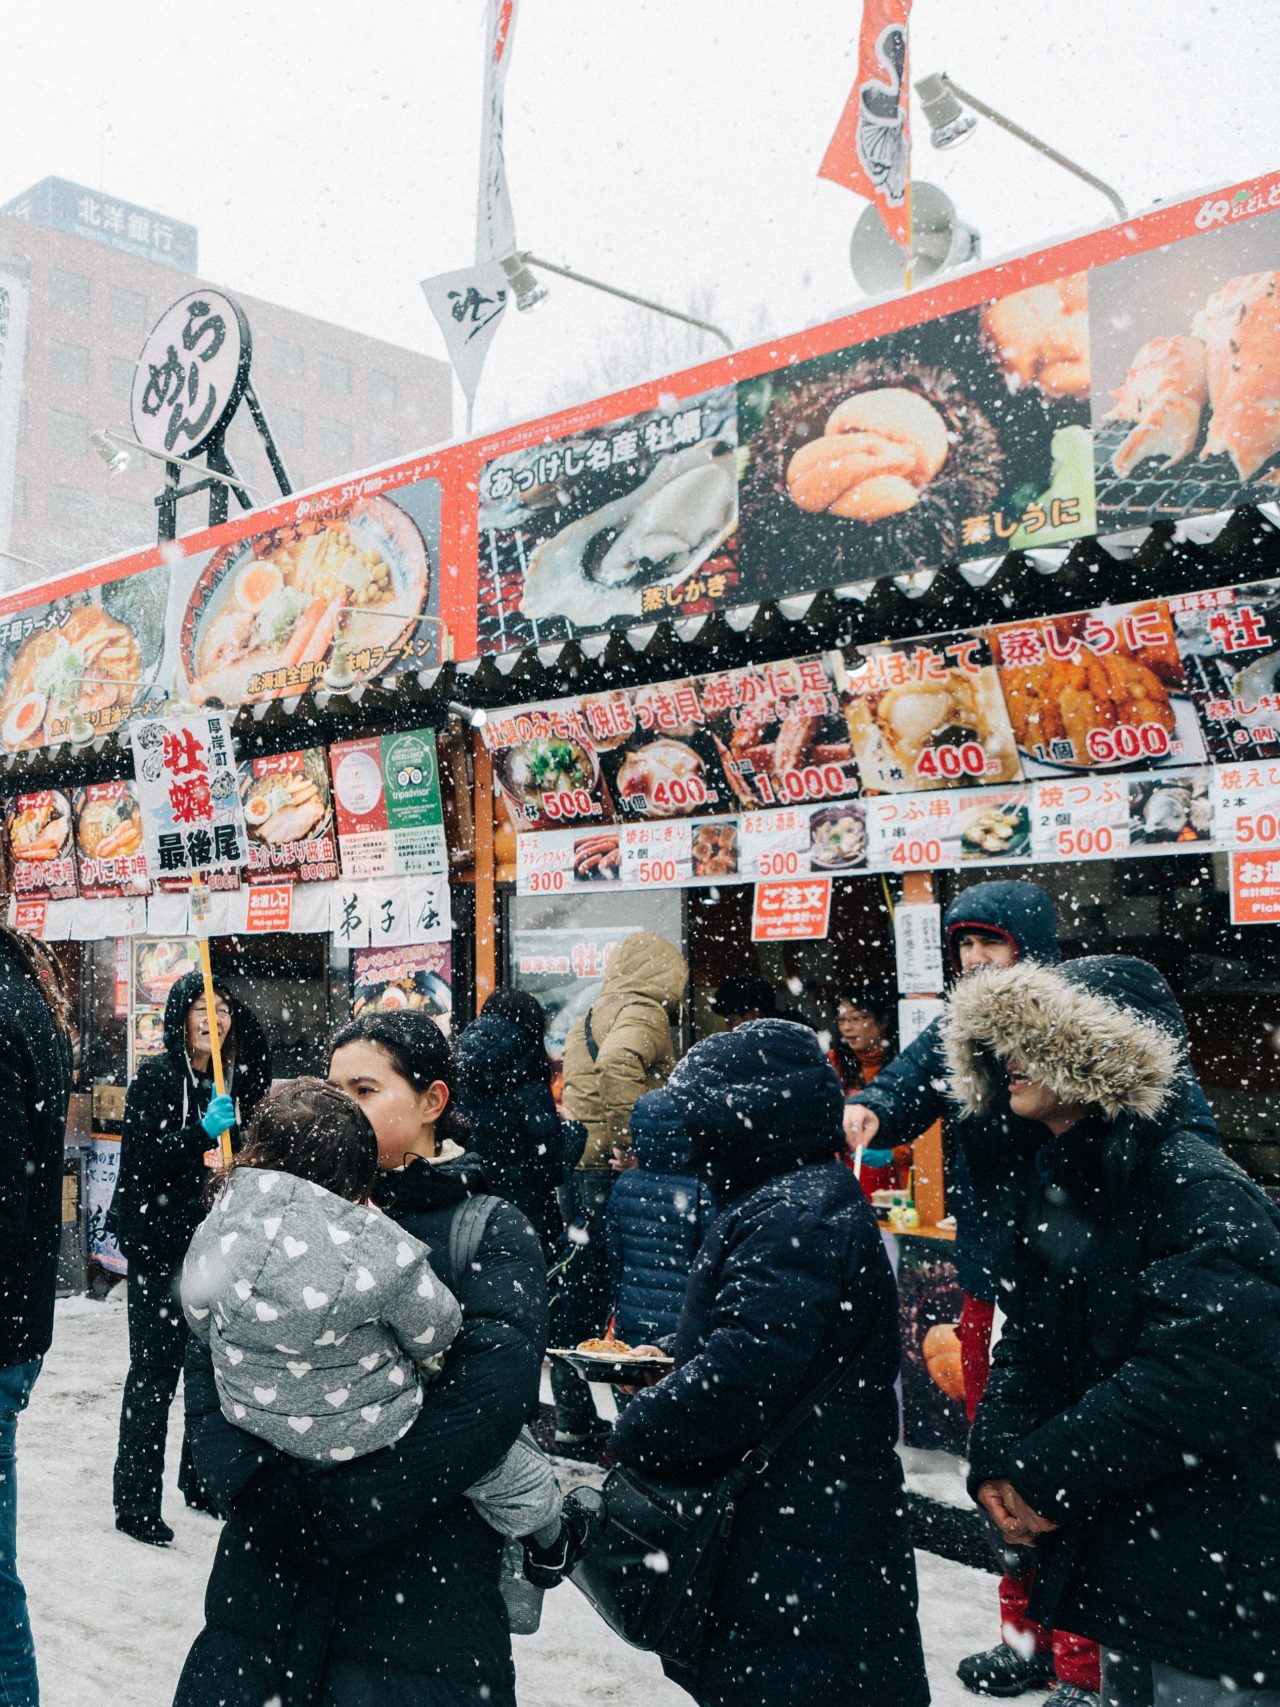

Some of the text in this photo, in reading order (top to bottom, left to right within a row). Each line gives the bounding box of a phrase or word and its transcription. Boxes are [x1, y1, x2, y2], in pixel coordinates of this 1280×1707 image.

[78, 195, 175, 251] 北洋銀行
[489, 428, 639, 499] あっけし名産
[645, 407, 703, 452] 牡蠣
[961, 498, 1080, 546] 蒸しうに
[641, 573, 728, 612] 蒸しかき
[997, 609, 1169, 669] 蒸しうに
[246, 638, 432, 695] 北海道全部の味噌ラーメン
[705, 661, 831, 709] 焼かに足
[484, 707, 585, 748] 牡蠣のみそ汁
[207, 717, 227, 767] 厚岸町
[1034, 738, 1075, 763] 1個
[162, 727, 215, 824] 牡蠣
[257, 754, 300, 776] ラーメン
[18, 792, 52, 811] ラーメン
[90, 782, 125, 800] ラーメン
[392, 788, 430, 801] tripadvisor
[1222, 797, 1247, 808] 2本
[743, 811, 805, 834] あさり酒蒸し
[876, 798, 952, 823] つぶ串
[1040, 811, 1072, 827] 2個
[625, 824, 687, 844] 焼おにぎり
[878, 823, 907, 839] 1串
[157, 823, 241, 871] 最後尾
[522, 851, 568, 865] フランクフルト
[626, 848, 649, 860] 2個
[82, 854, 148, 885] かに味噌
[300, 862, 338, 881] 800円
[760, 884, 825, 911] ご注文
[339, 889, 441, 941] 弟子屈
[572, 941, 614, 978] 牡
